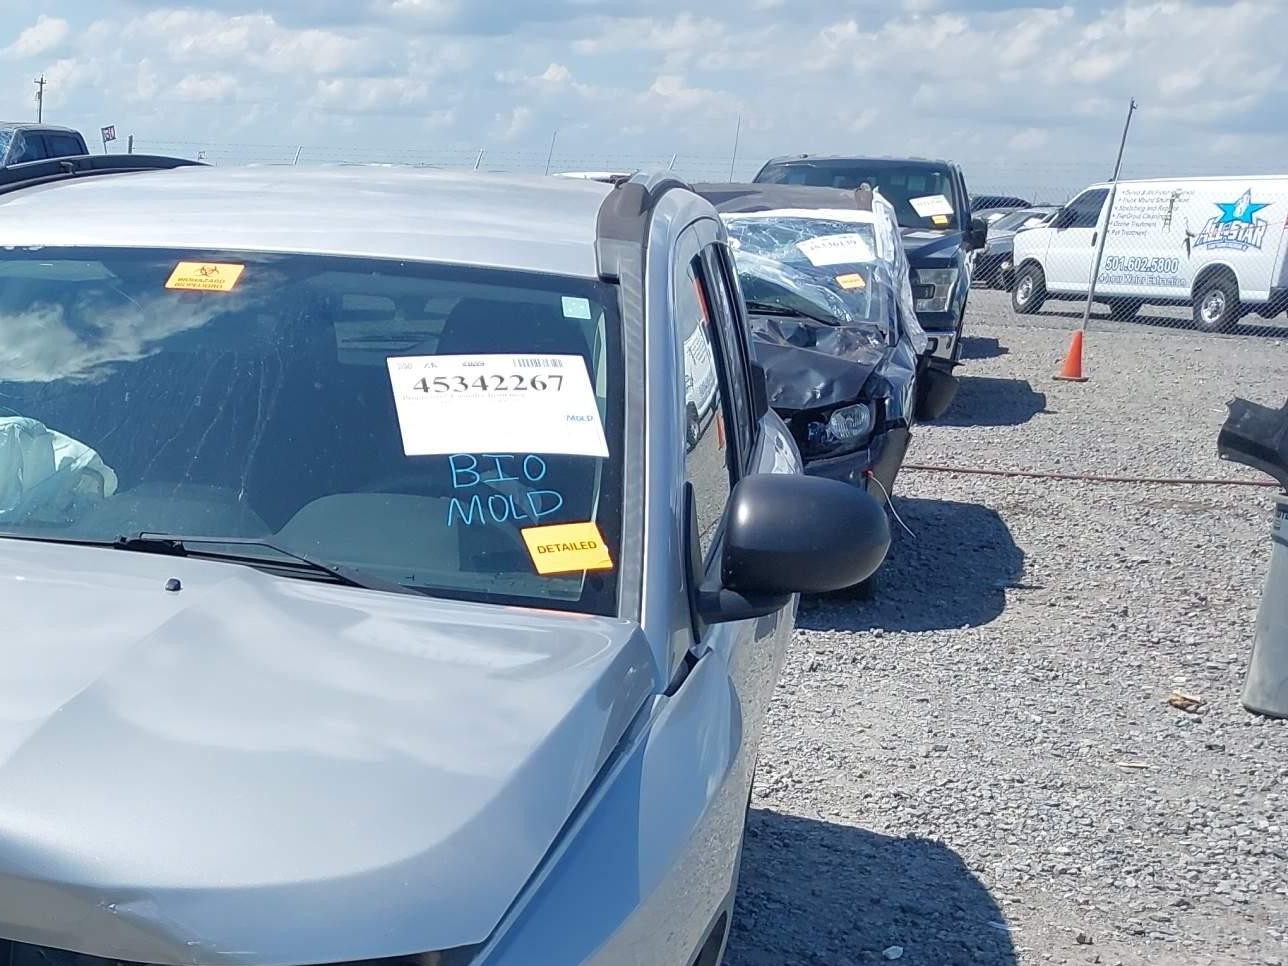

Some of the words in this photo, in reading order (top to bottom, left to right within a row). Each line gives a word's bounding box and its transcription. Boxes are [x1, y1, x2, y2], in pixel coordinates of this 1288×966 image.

[1105, 255, 1180, 274] 501.602.5800
[413, 374, 563, 393] 45342267
[448, 454, 546, 488] BIO
[447, 490, 563, 526] MOLD
[537, 540, 597, 554] DETAILED
